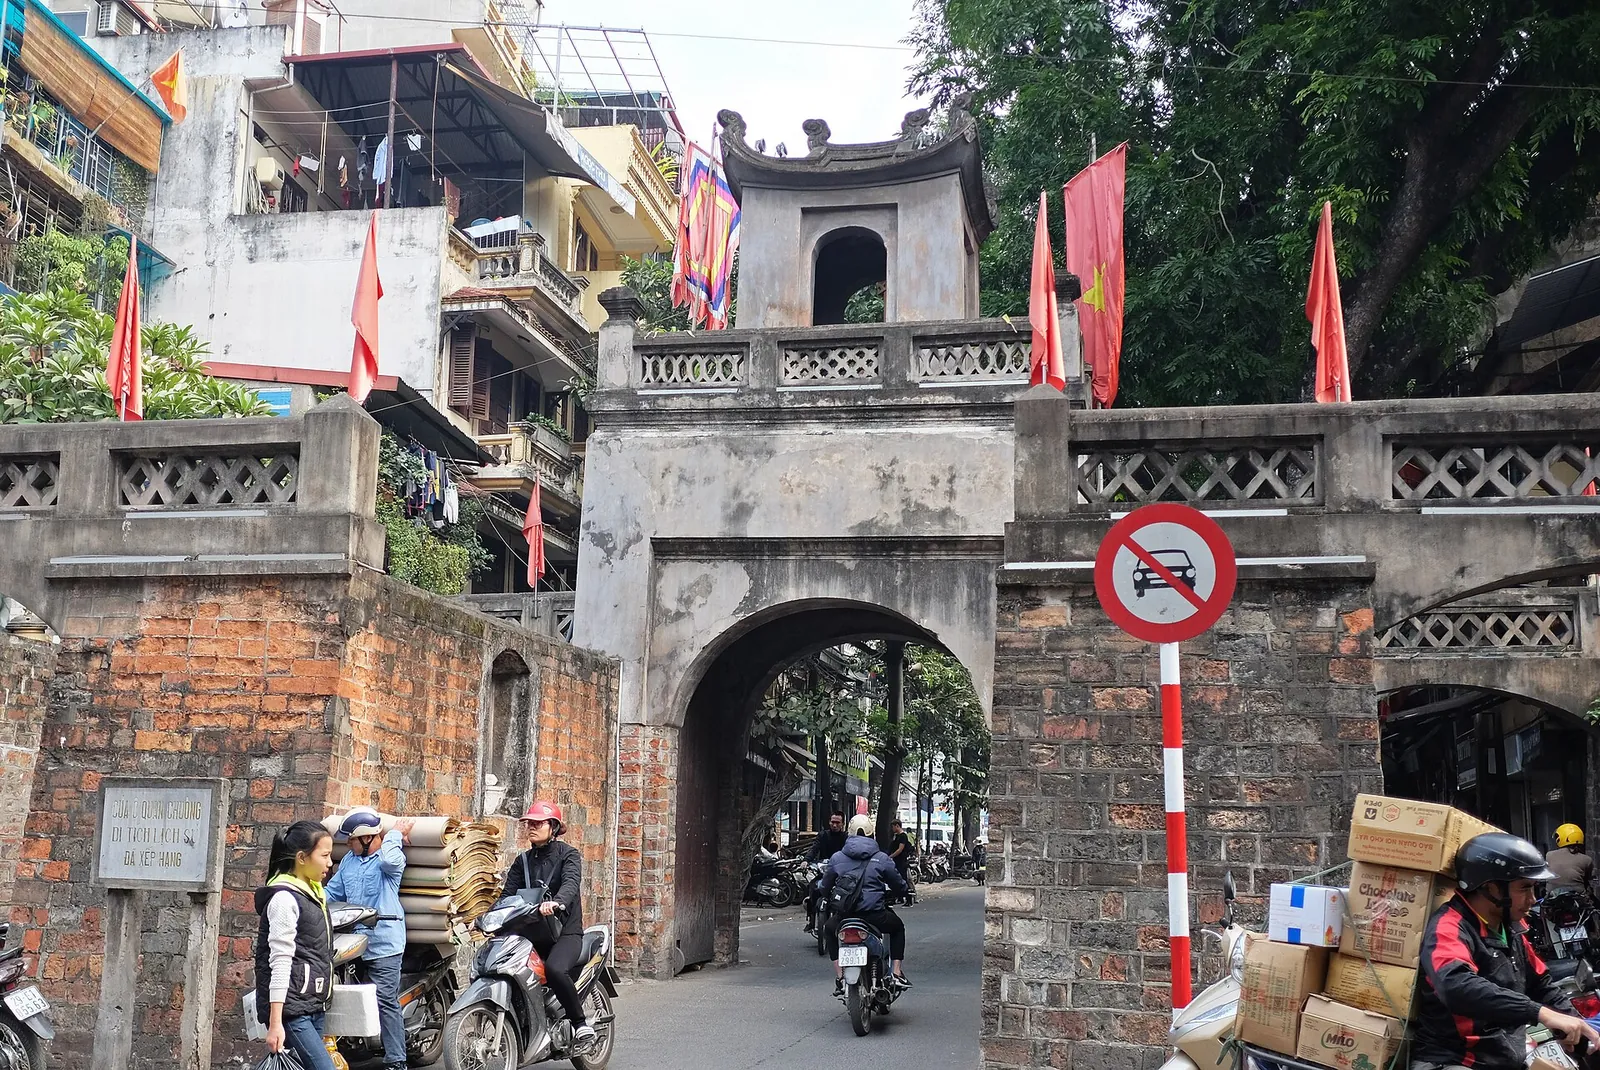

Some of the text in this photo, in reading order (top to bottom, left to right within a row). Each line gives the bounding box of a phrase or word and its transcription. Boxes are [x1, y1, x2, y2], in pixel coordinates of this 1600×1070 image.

[141, 800, 163, 820] QUAN
[1363, 799, 1383, 807] OPEN
[112, 826, 122, 842] DI
[158, 851, 182, 870] HẠNG
[1359, 882, 1416, 903] Chocolate
[1325, 1033, 1355, 1047] MILO
